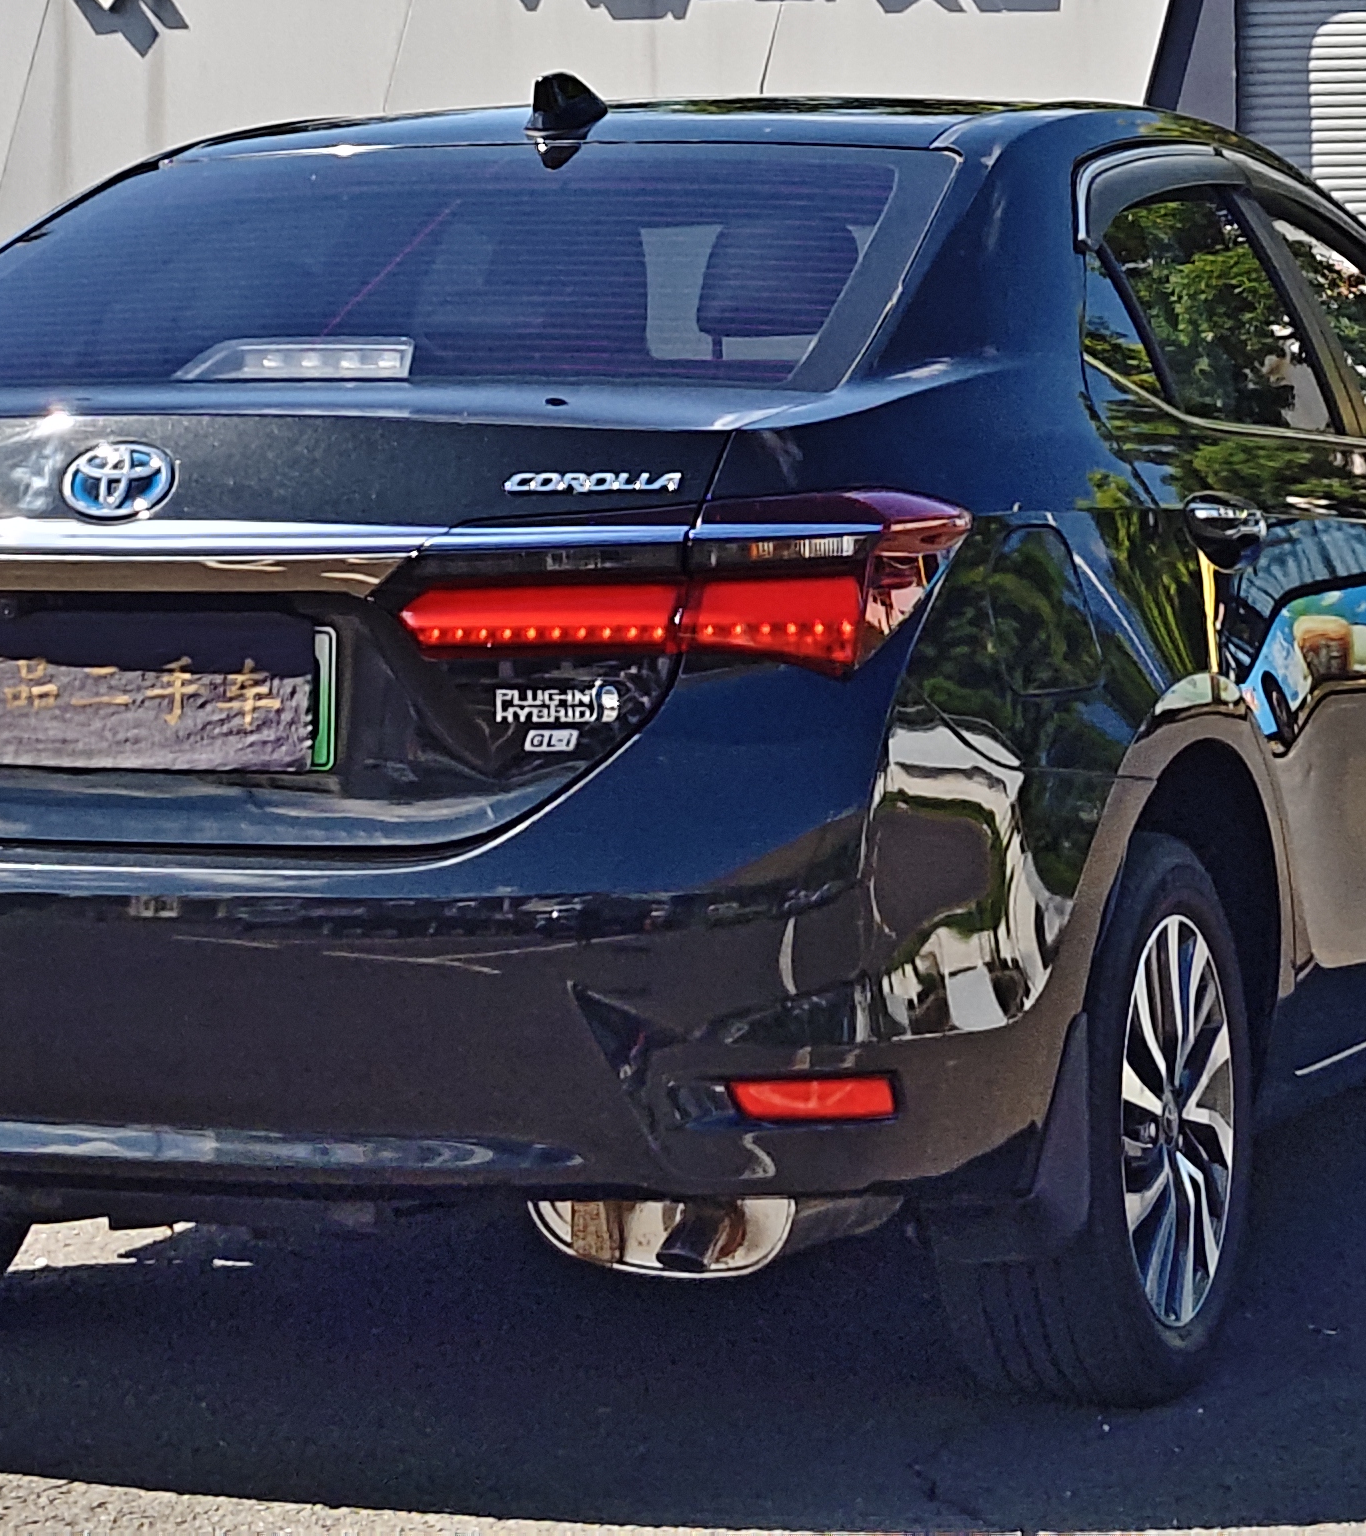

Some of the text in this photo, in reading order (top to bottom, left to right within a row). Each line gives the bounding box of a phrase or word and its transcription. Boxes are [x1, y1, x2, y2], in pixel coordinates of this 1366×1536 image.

[502, 472, 683, 495] COROLLA
[495, 688, 592, 706] PLUG-IN
[495, 706, 593, 723] HYBRID
